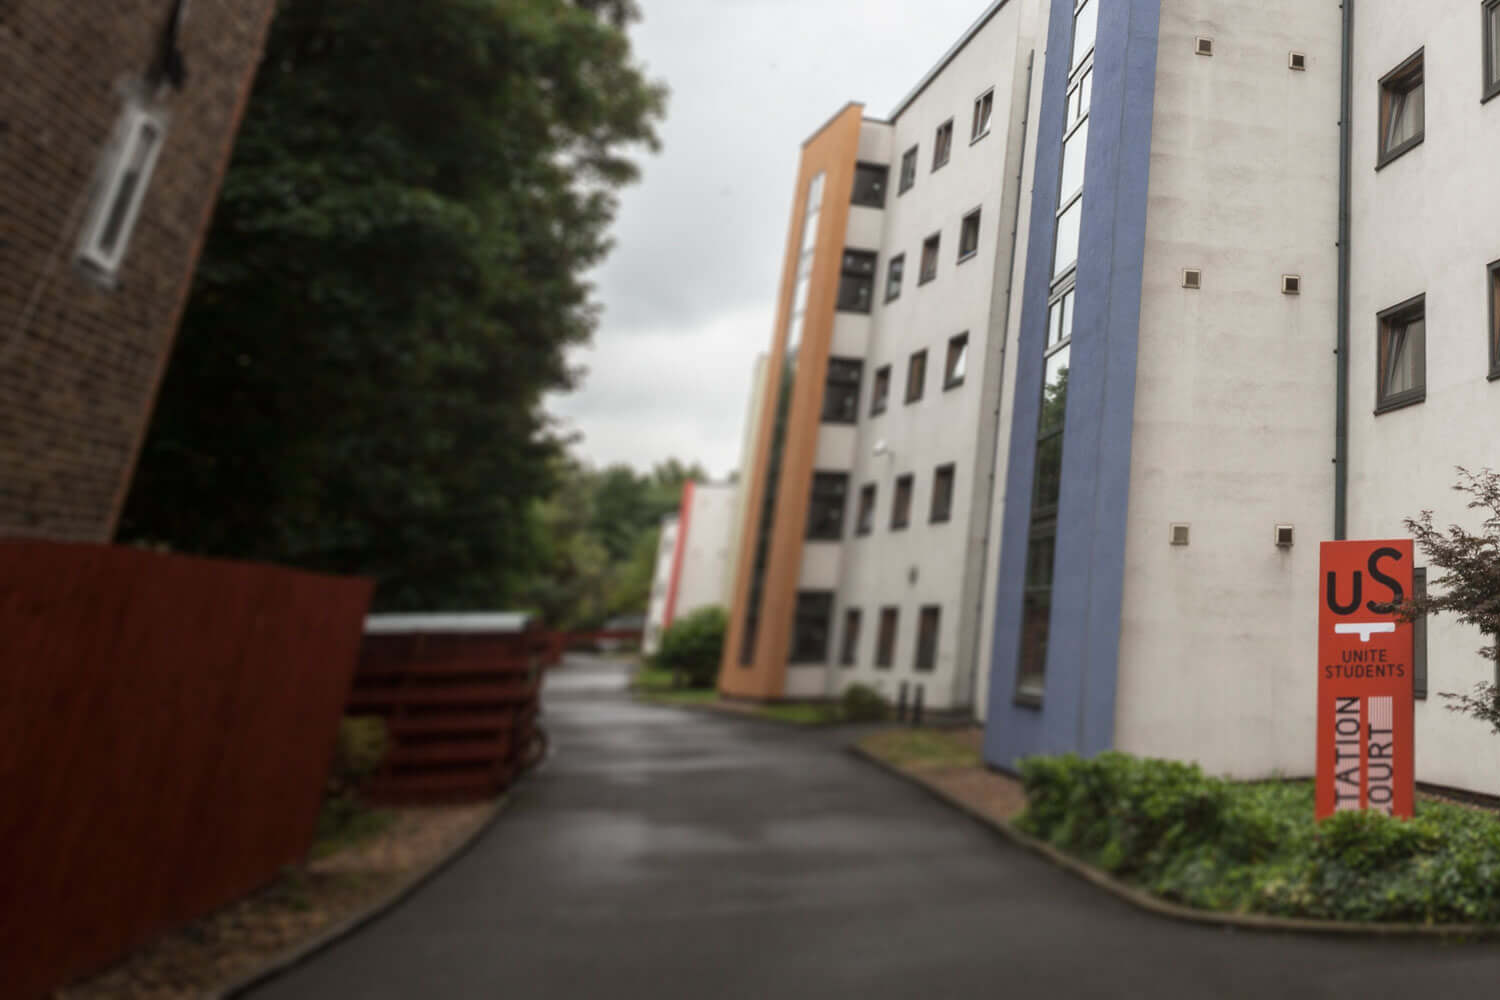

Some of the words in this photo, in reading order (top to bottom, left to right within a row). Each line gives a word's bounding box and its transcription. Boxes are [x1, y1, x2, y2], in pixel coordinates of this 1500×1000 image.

[1341, 648, 1387, 663] UNITE
[1325, 663, 1405, 679] STUDENTS
[1334, 696, 1360, 808] TATION
